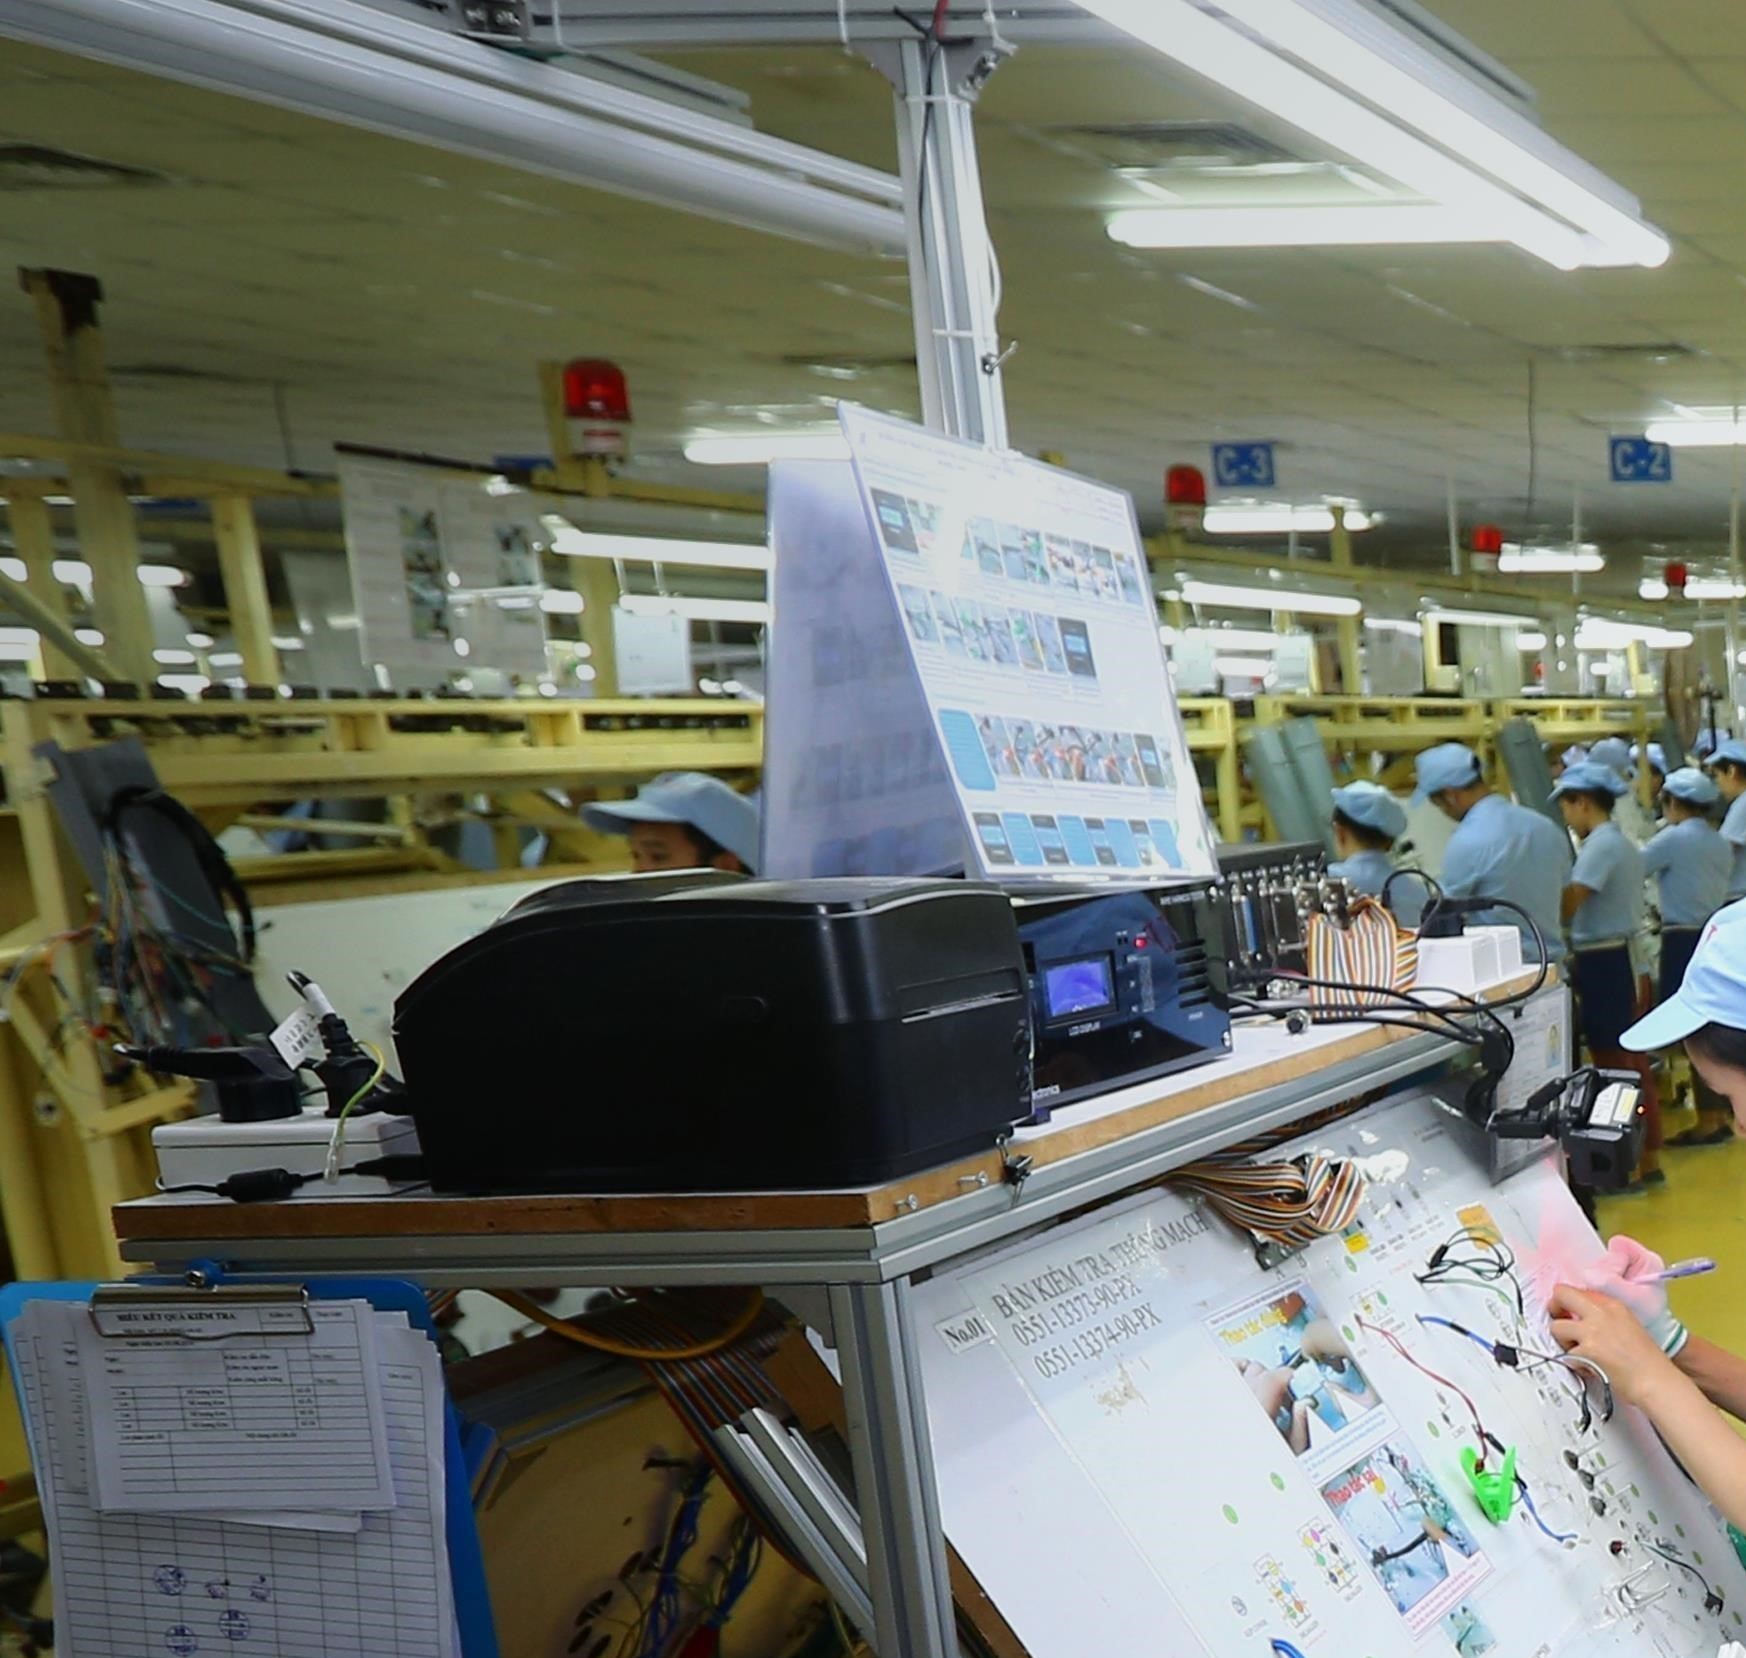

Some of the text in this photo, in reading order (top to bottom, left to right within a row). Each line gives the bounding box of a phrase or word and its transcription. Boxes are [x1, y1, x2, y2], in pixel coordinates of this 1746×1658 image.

[1217, 446, 1268, 481] C-3
[1614, 441, 1665, 475] C-2
[944, 1317, 987, 1348] No.01
[1325, 1484, 1353, 1506] Thao
[1349, 1476, 1367, 1496] tác
